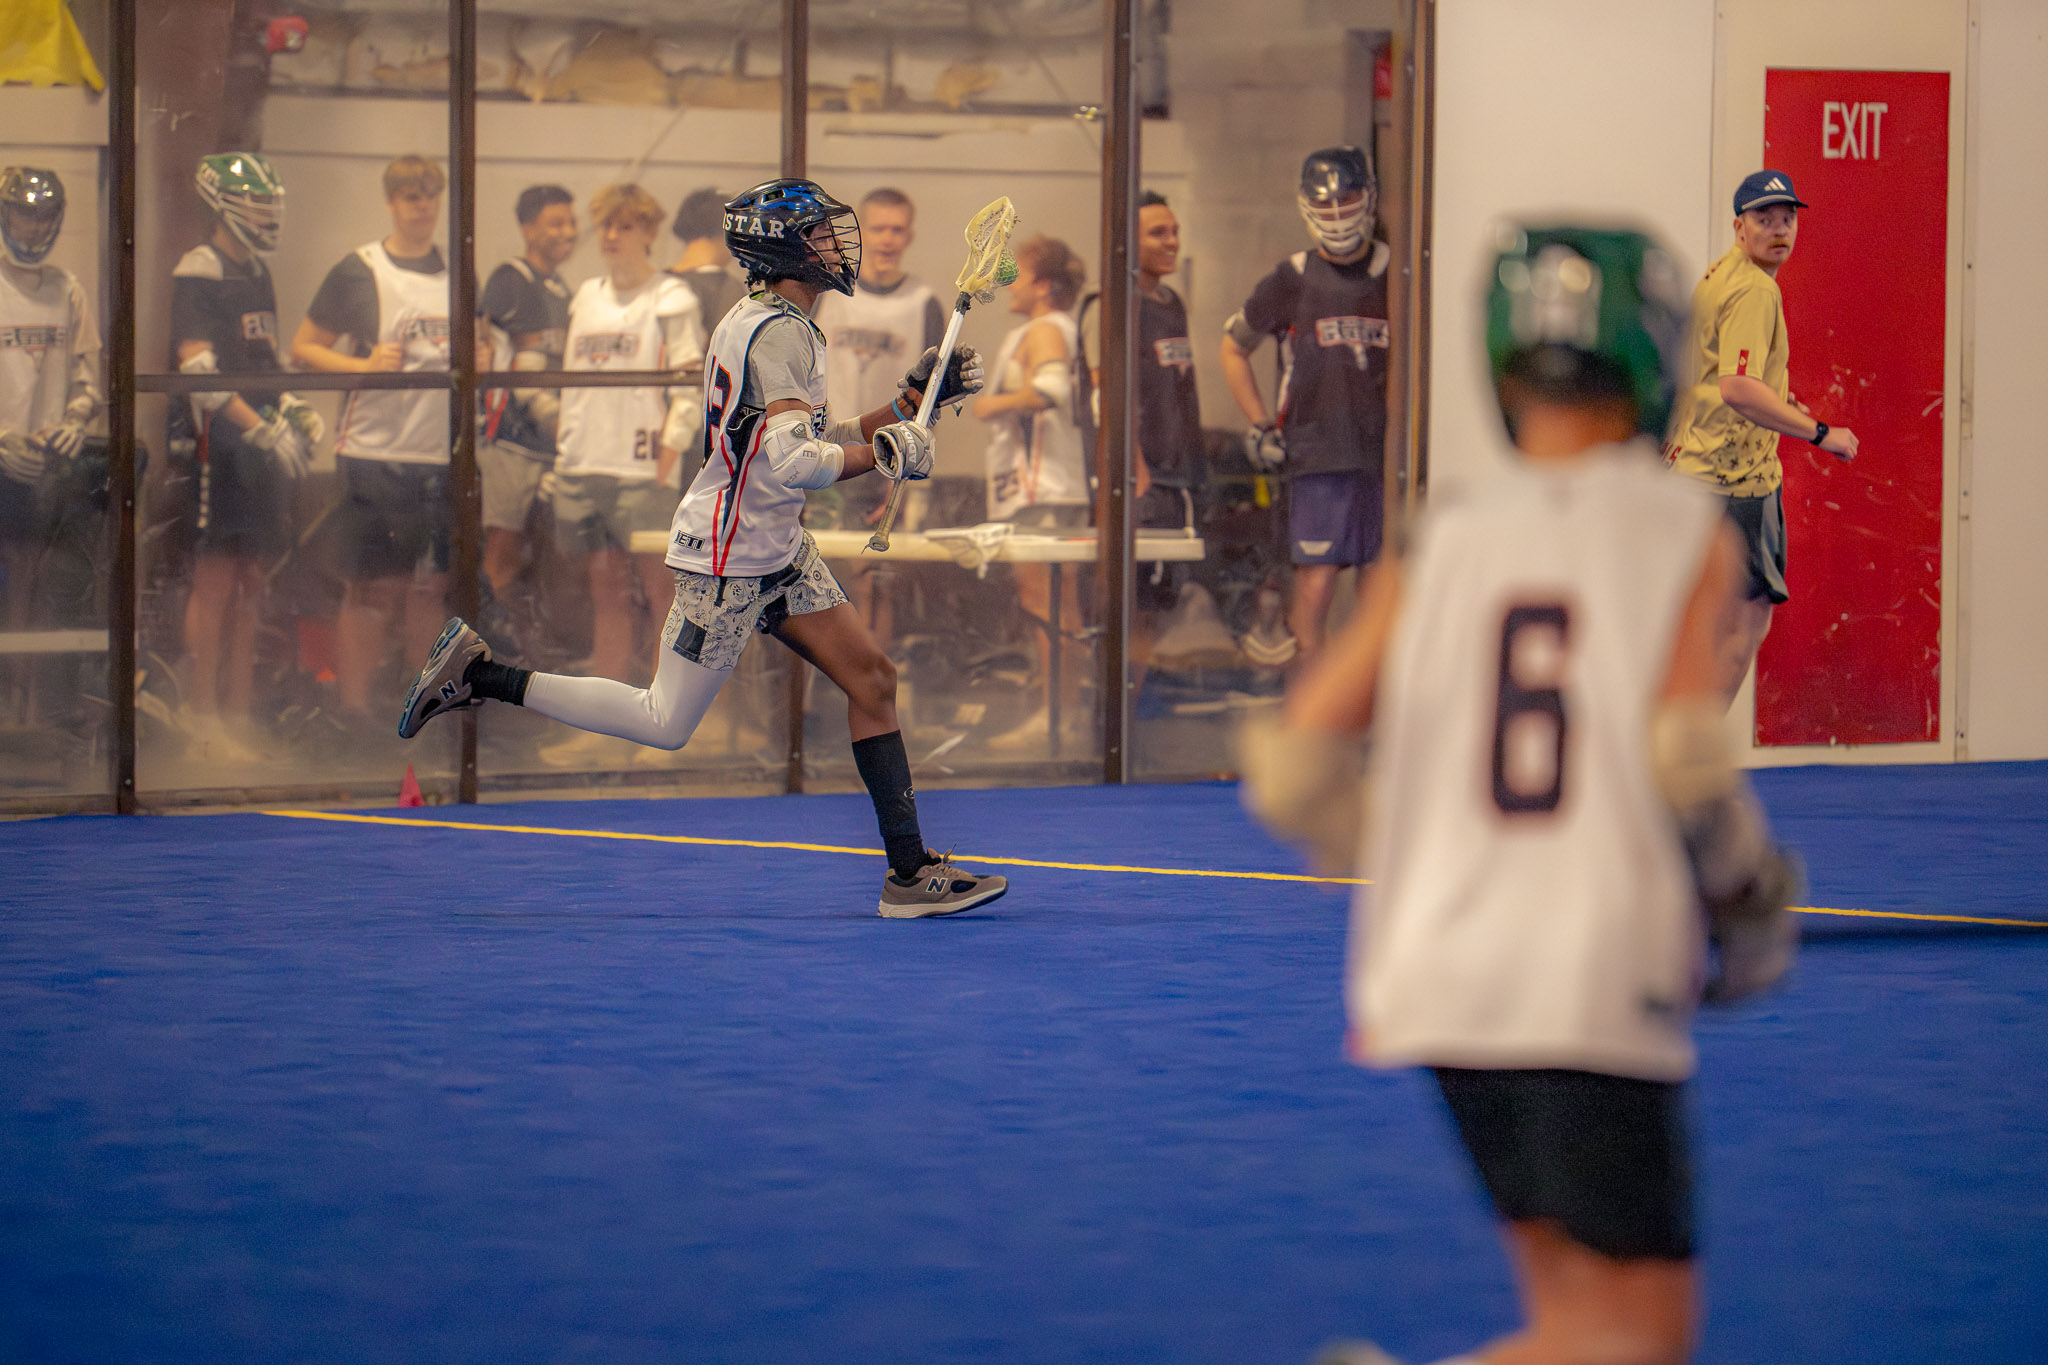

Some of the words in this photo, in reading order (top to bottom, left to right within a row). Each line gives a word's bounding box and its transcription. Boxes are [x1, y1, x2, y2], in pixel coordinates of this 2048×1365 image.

[1823, 101, 1888, 160] EXIT
[723, 212, 785, 239] STAR
[439, 680, 457, 700] N
[1493, 604, 1568, 814] 6
[926, 877, 948, 893] N
